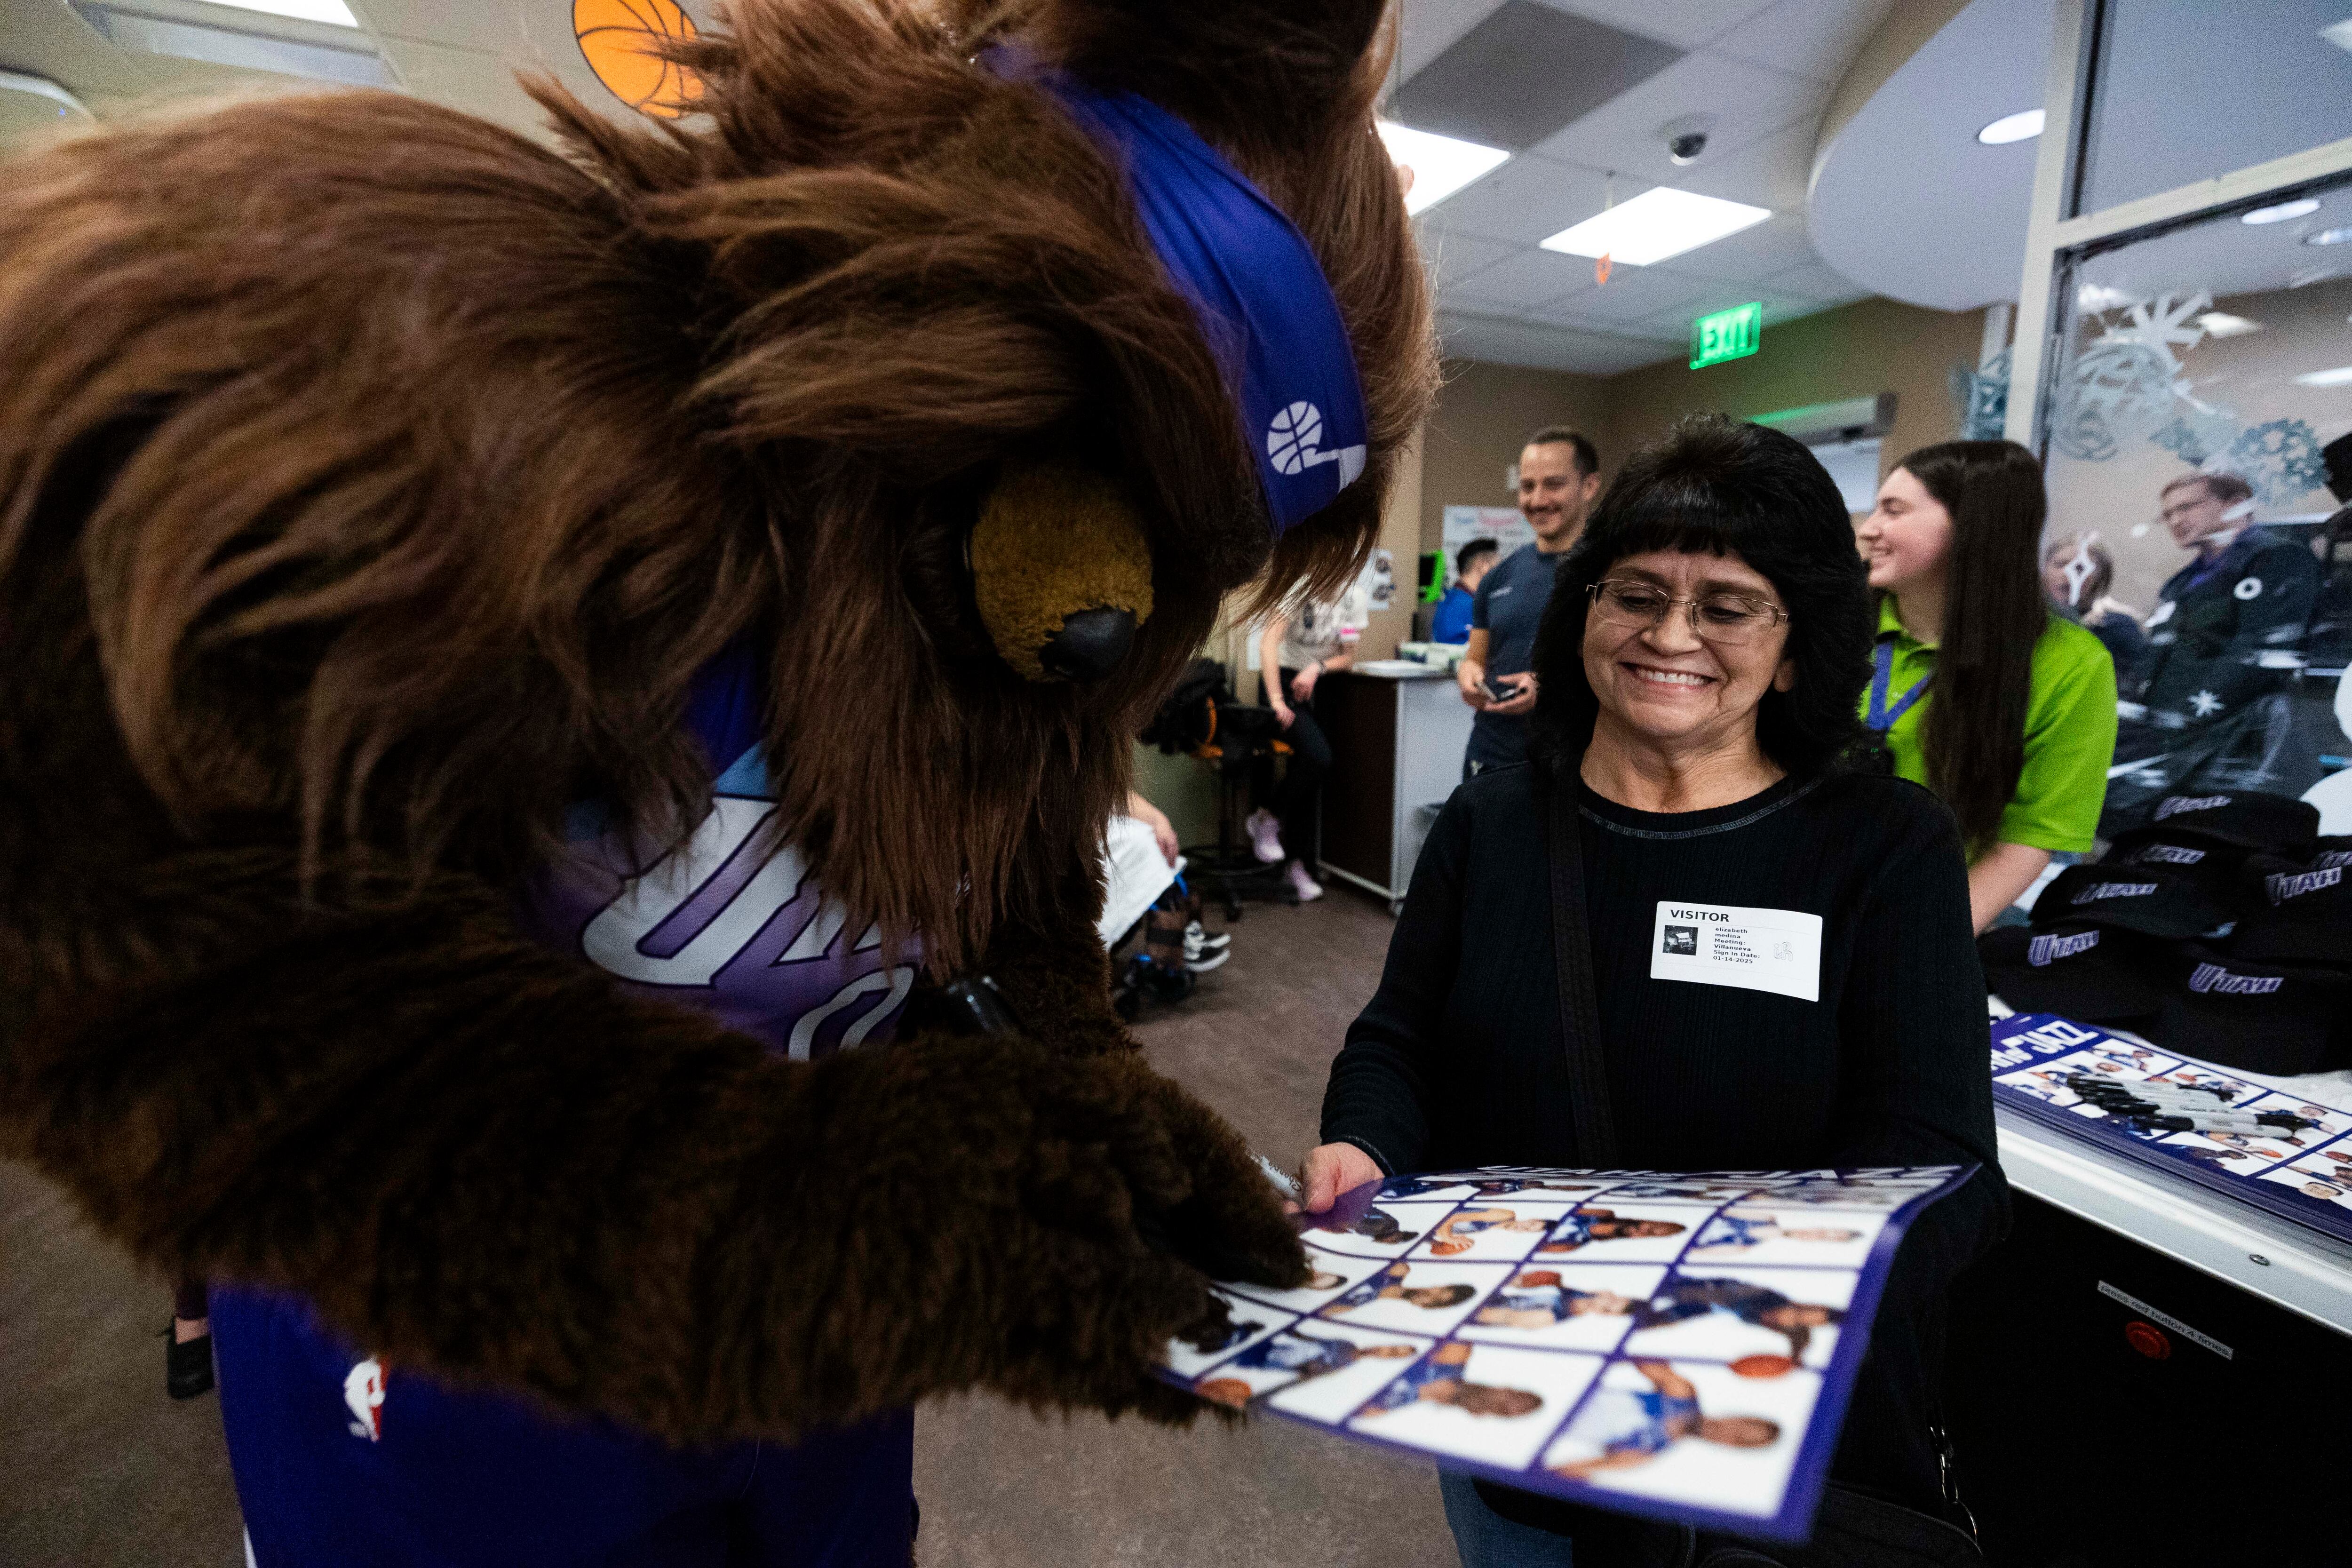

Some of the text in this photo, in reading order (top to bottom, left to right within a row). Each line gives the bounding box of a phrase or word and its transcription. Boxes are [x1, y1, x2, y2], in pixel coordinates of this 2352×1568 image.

[1700, 308, 1754, 360] EXIT
[1670, 909, 1730, 922] VISITOR
[2189, 963, 2284, 994] UTAH
[1477, 1165, 1963, 1179] UTAH JAZZ
